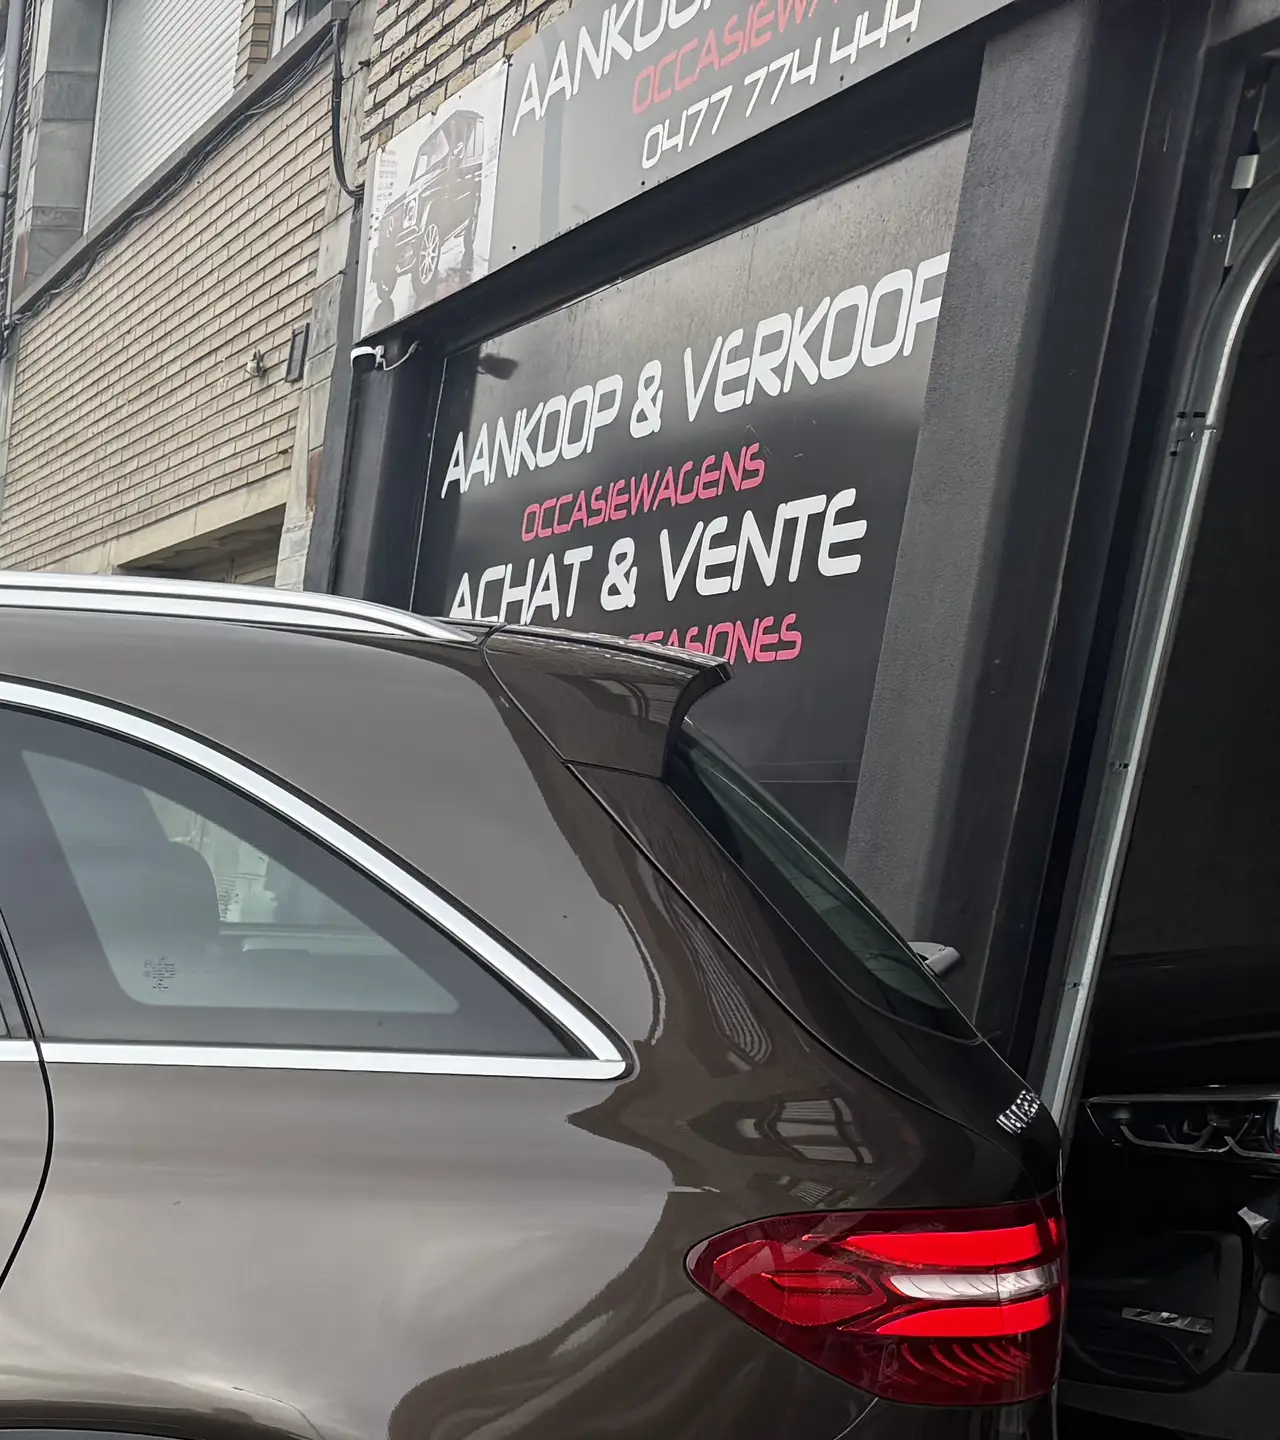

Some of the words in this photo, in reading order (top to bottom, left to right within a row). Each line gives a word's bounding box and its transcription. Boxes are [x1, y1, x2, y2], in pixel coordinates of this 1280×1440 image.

[512, 0, 711, 136] AANKO
[642, 85, 732, 169] 0477
[743, 37, 822, 117] 774
[829, 0, 923, 64] 444
[441, 374, 623, 498] AANKOOP
[630, 359, 663, 438] &
[521, 443, 766, 541] OCCASIEWAGENS
[448, 547, 593, 625] ACHAT
[600, 537, 638, 611] &
[660, 488, 868, 602] VENTE
